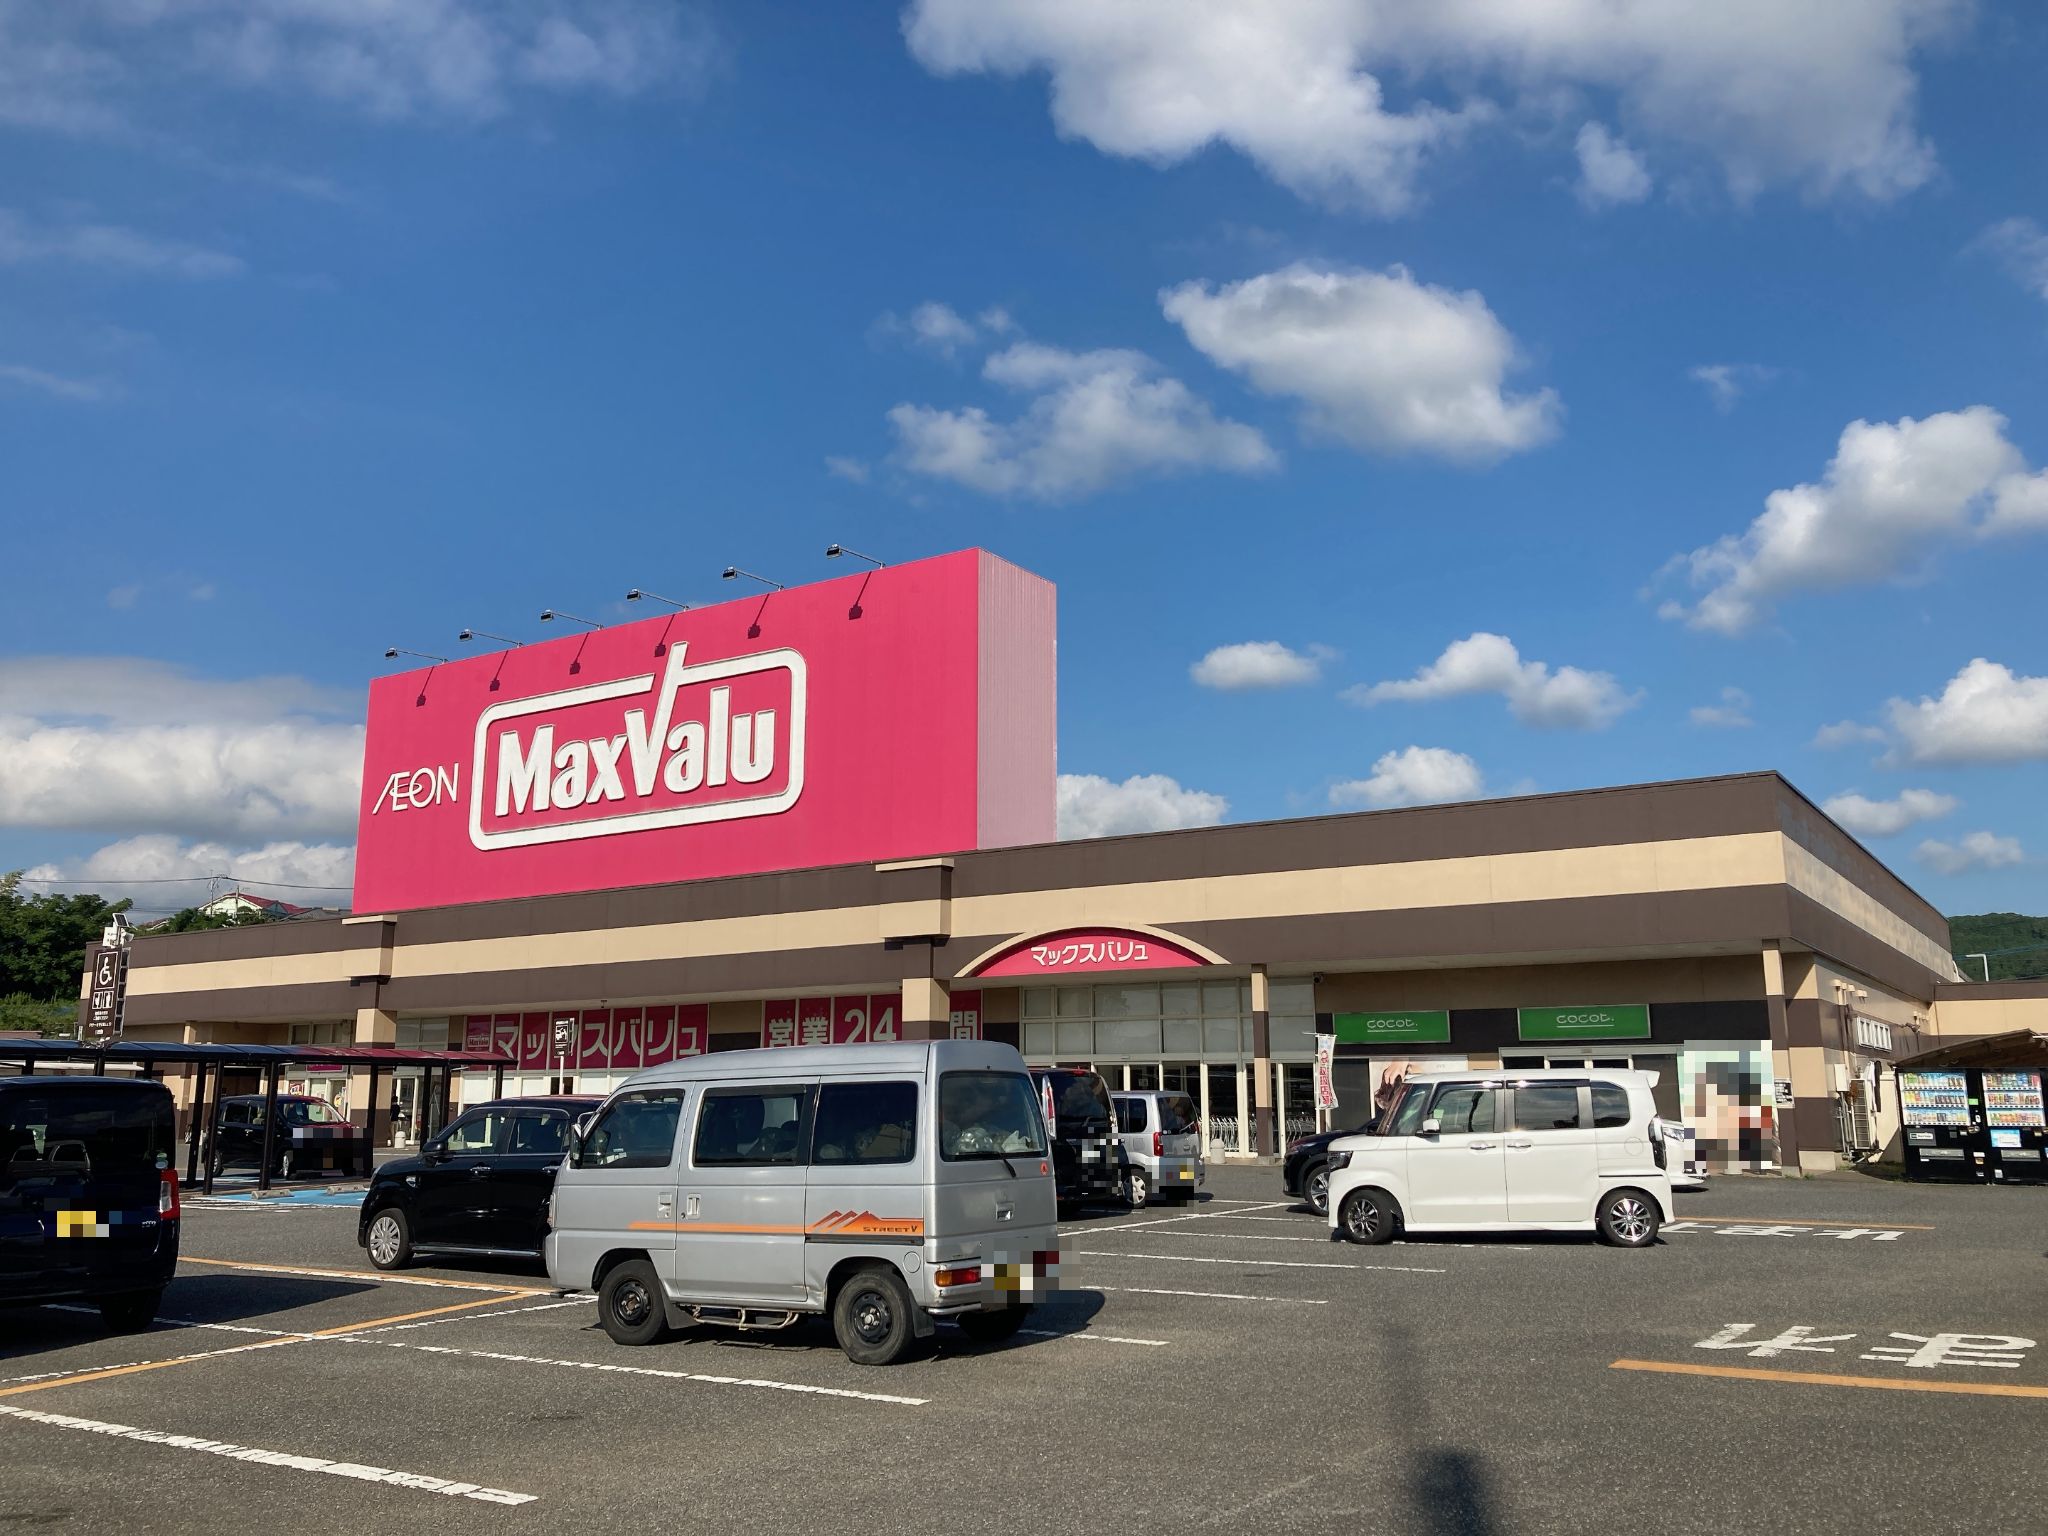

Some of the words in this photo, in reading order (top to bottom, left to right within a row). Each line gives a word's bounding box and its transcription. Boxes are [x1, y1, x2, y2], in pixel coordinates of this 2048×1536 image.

[494, 641, 776, 817] MaxValu
[1030, 940, 1149, 967] マックスバリュ
